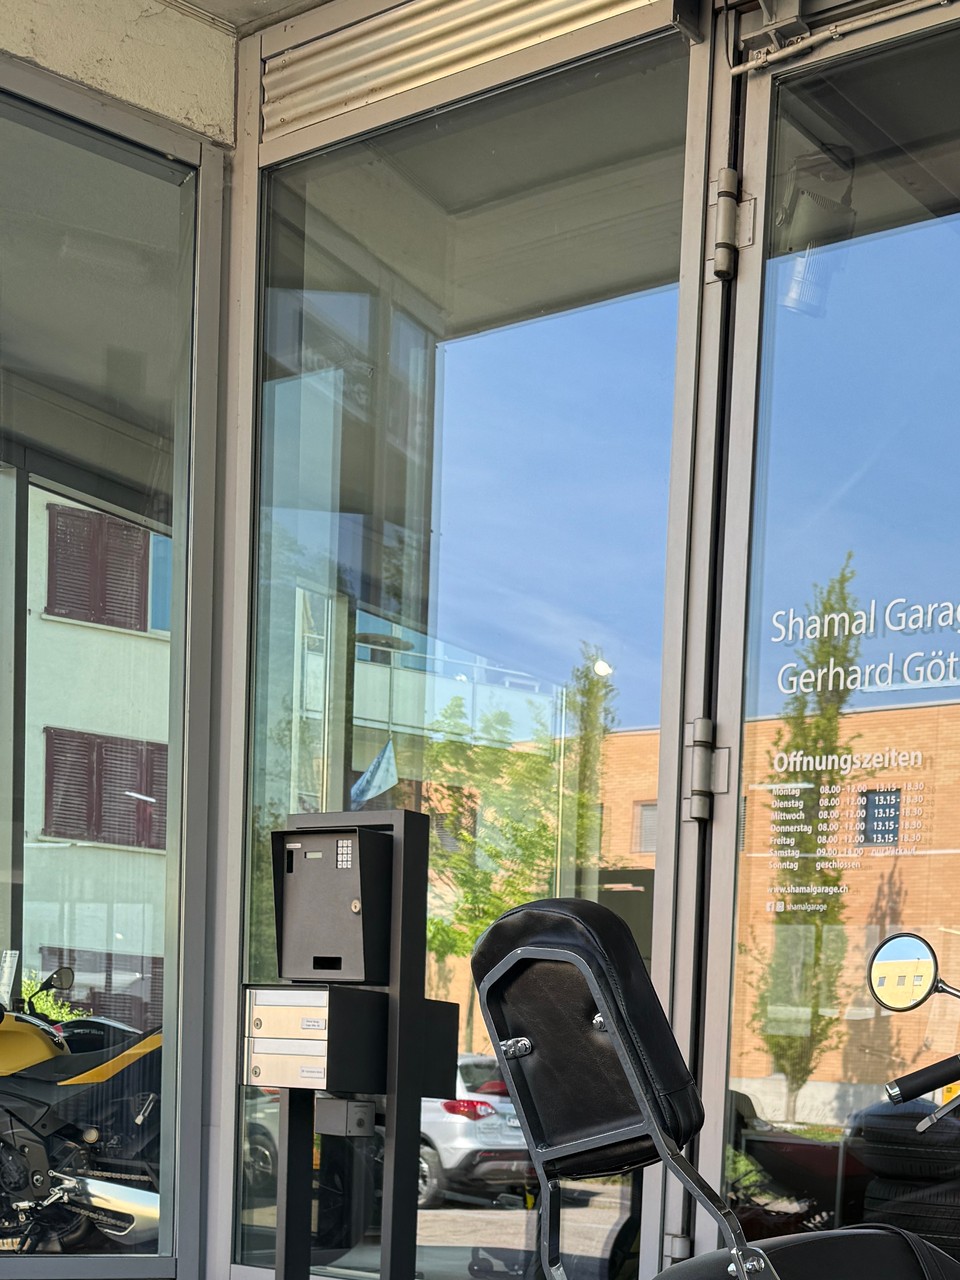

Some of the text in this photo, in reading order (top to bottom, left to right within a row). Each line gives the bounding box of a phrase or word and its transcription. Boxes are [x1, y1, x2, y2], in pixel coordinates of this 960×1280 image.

[771, 599, 876, 643] Shamal
[777, 652, 894, 694] Gerhard
[771, 788, 800, 797] Montag
[771, 800, 804, 809] Dienstag
[770, 811, 805, 820] Mittwoch
[770, 823, 813, 834] Donnerstag
[769, 836, 795, 847] Freitag
[768, 859, 861, 871] Sonntag geschlossen
[768, 884, 849, 895] www.shamalgarage.ch
